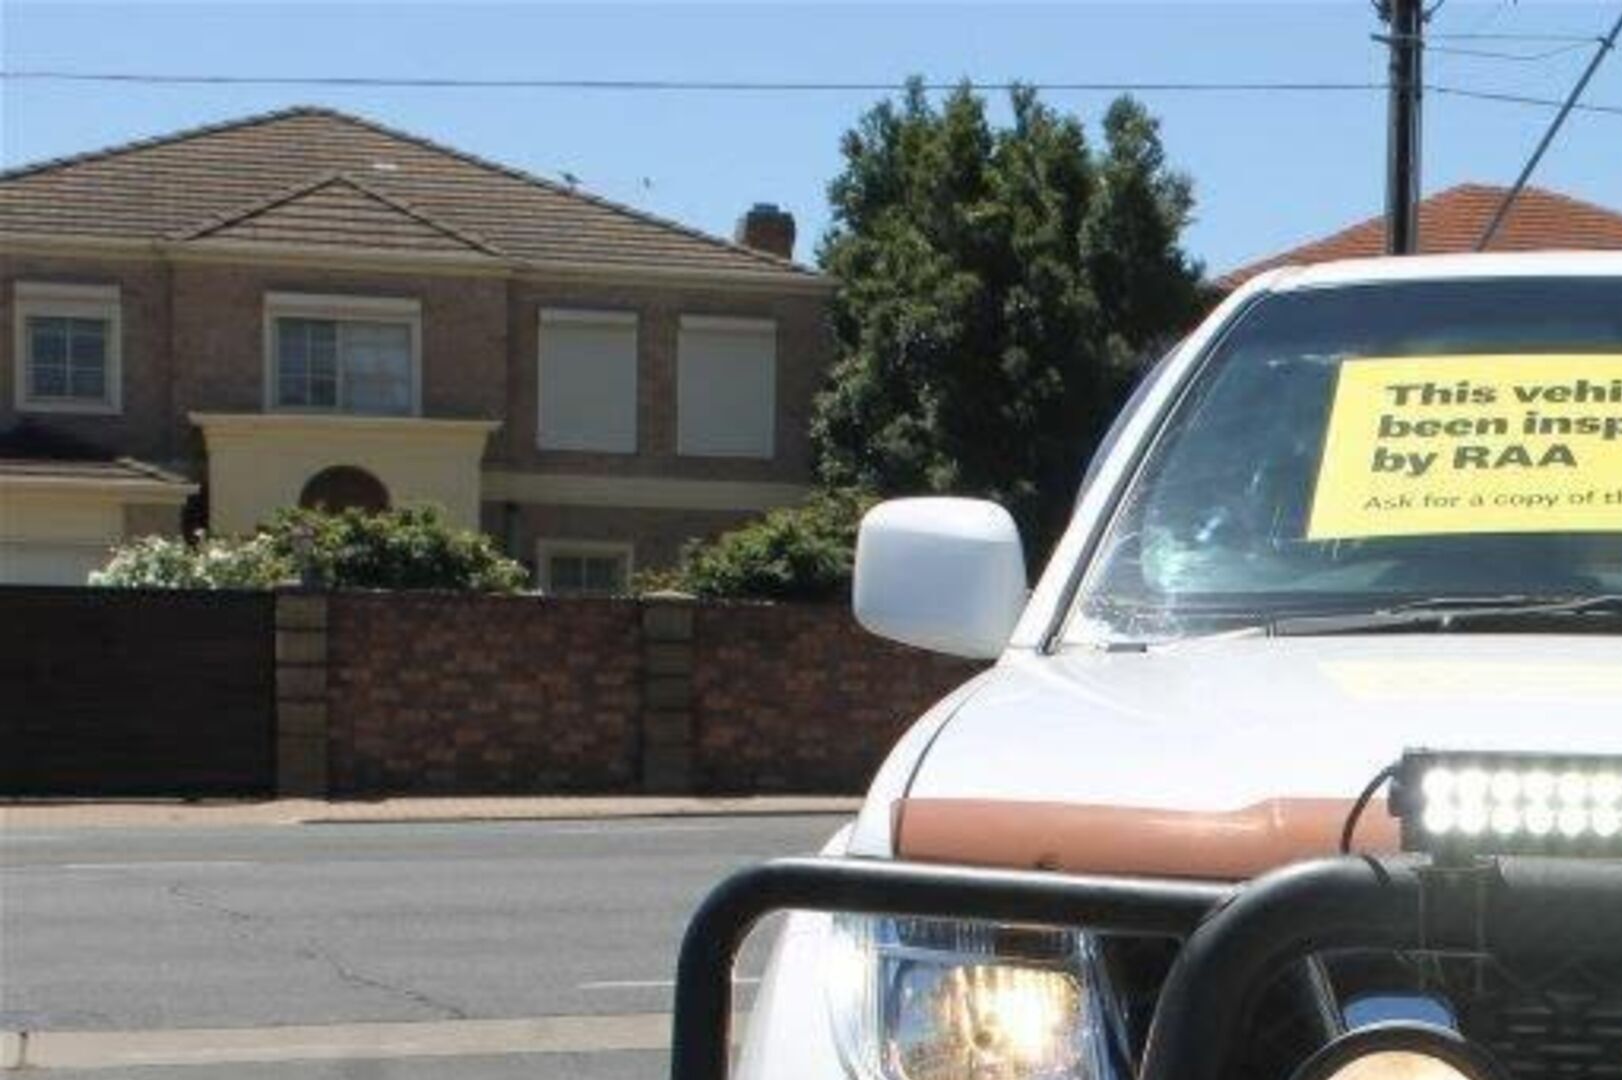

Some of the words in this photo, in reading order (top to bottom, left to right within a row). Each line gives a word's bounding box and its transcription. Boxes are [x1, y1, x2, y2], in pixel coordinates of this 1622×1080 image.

[1386, 381, 1498, 406] This
[1377, 414, 1509, 438] been
[1371, 446, 1438, 477] by
[1452, 443, 1578, 469] RAA
[1363, 494, 1412, 511] Ask
[1423, 494, 1461, 508] for
[1469, 495, 1484, 508] a
[1493, 493, 1560, 509] copy
[1569, 490, 1595, 506] of
